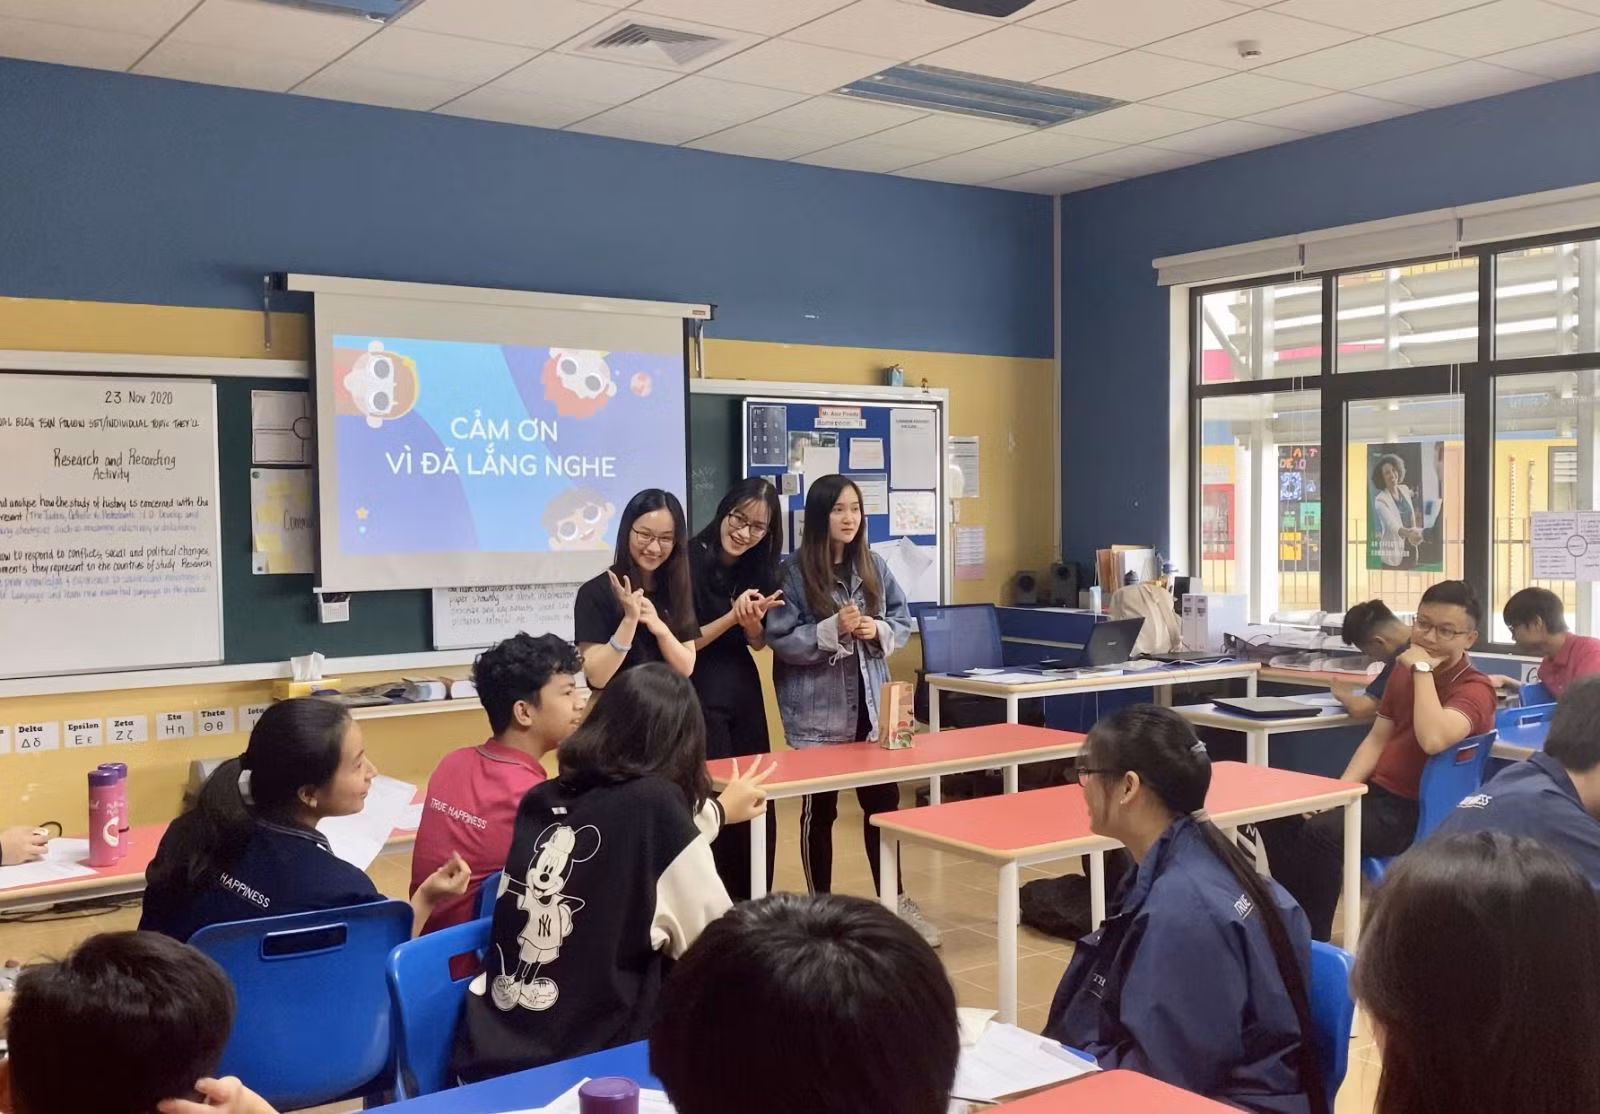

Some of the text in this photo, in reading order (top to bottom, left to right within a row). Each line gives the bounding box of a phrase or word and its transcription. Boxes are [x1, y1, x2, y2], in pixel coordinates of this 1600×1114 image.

[105, 390, 173, 405] 23 Nov 2020
[450, 409, 558, 443] CẢM ƠN
[54, 448, 176, 471] Research and Recording
[385, 443, 616, 477] VÌ ĐÃ LẮNG NGHE
[93, 466, 130, 483] Activity
[40, 493, 54, 507] how
[55, 496, 69, 508] the
[70, 497, 89, 512] study
[140, 498, 173, 508] concerned
[177, 497, 194, 507] with
[196, 495, 208, 507] the
[14, 549, 23, 561] to
[25, 549, 54, 567] respond
[56, 549, 65, 560] to
[129, 546, 143, 557] and
[147, 544, 177, 561] political
[32, 563, 49, 575] they
[51, 561, 84, 576] represent
[98, 561, 110, 571] the
[147, 559, 155, 572] of
[156, 558, 176, 572] study
[167, 713, 182, 721] Eta
[201, 709, 225, 718] Theta
[18, 725, 43, 734] Delta
[68, 722, 99, 732] Epsilon
[114, 719, 134, 728] Zeta
[431, 797, 488, 829] TRUE HAPPINESS
[219, 872, 271, 908] HAPPINESS
[1233, 893, 1252, 917] TRUE
